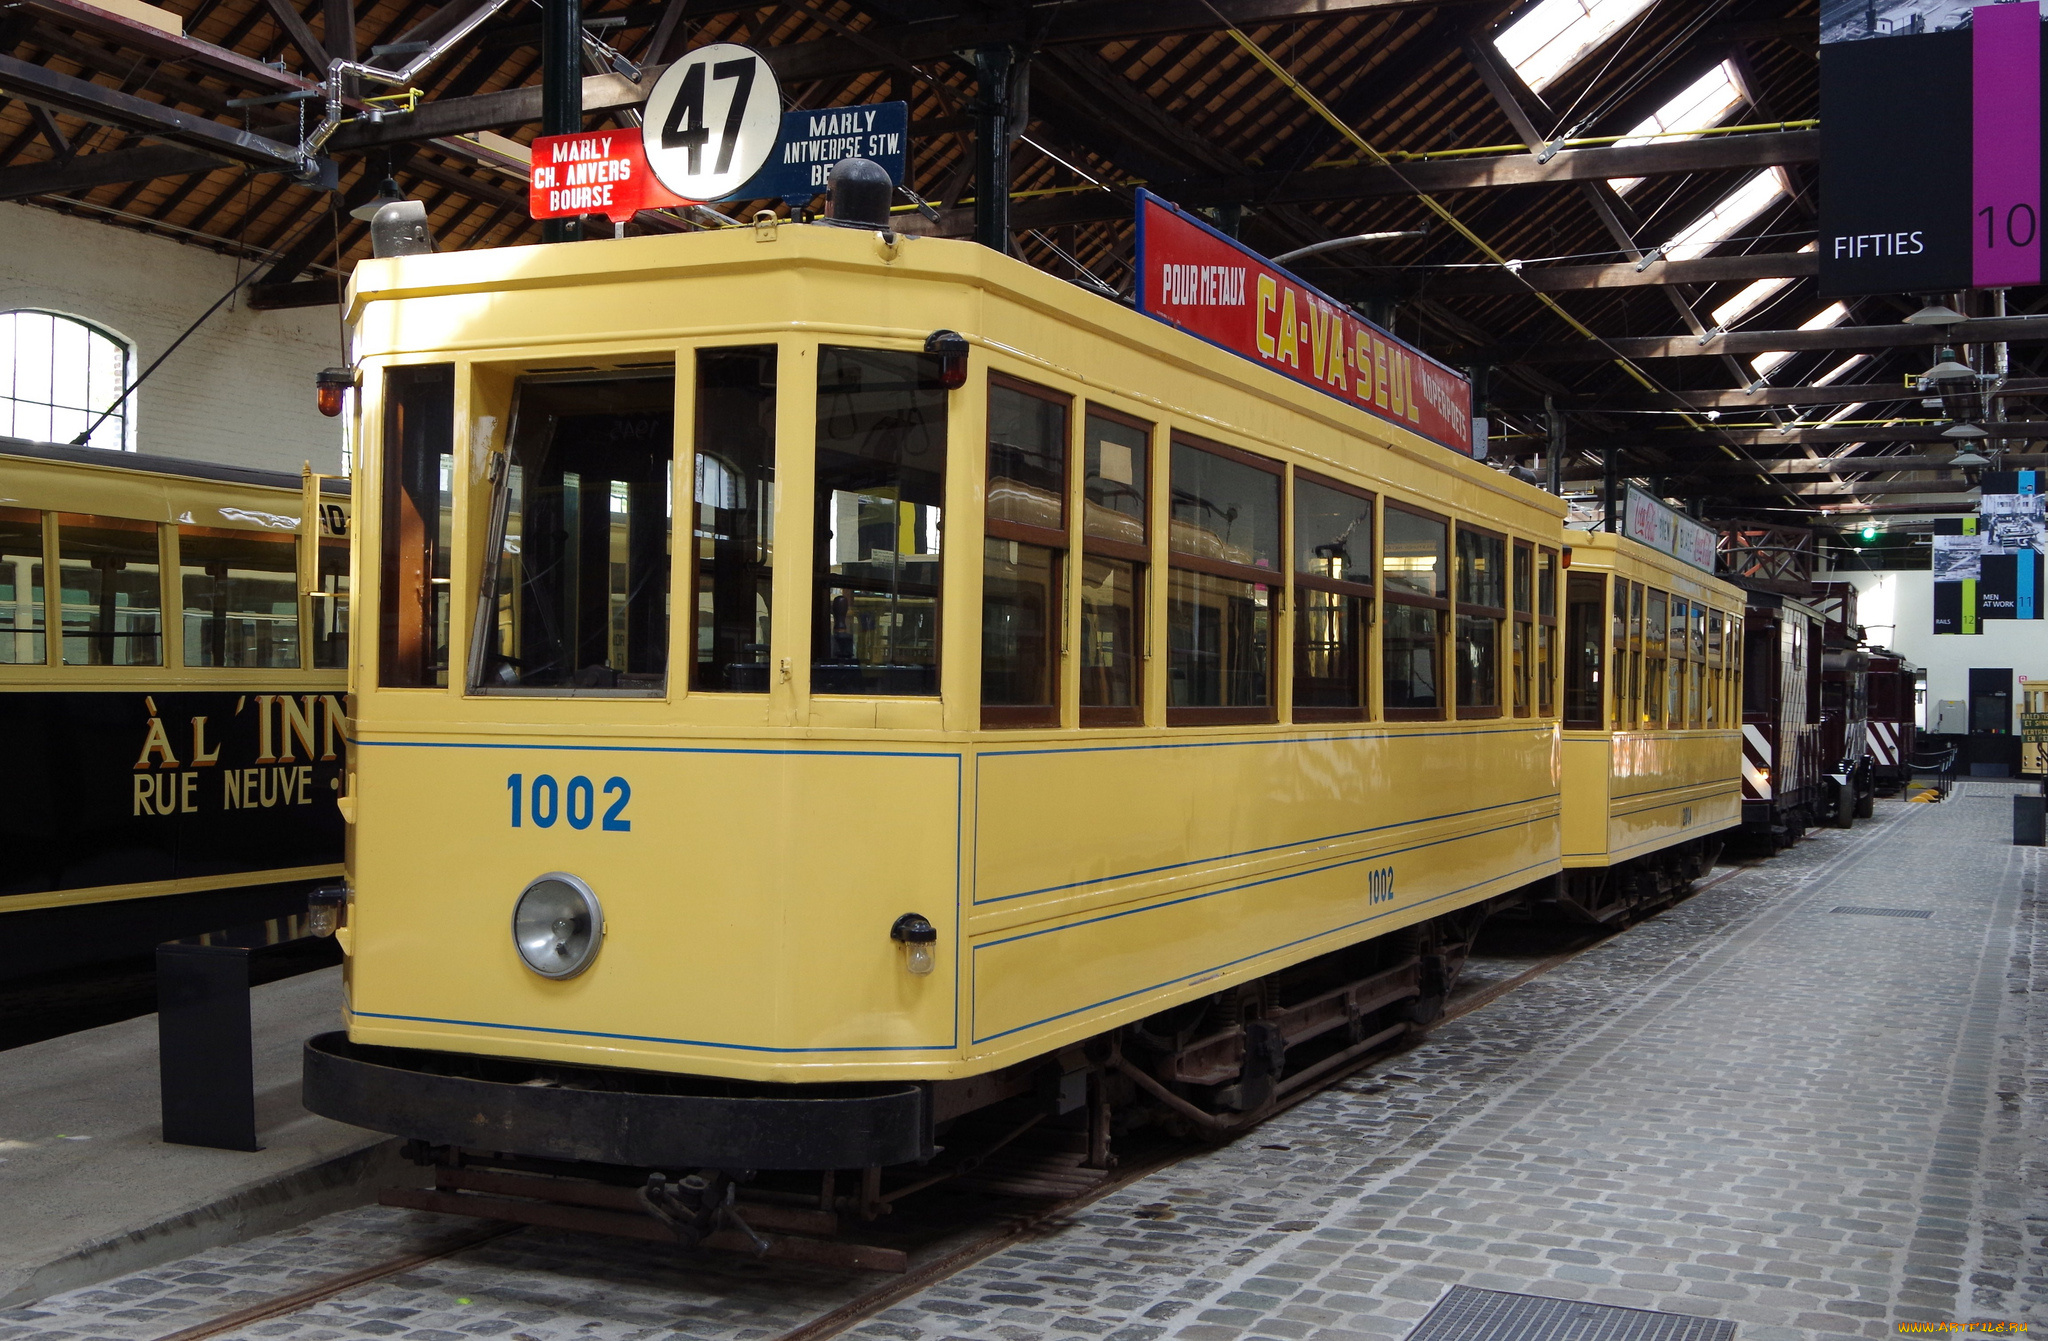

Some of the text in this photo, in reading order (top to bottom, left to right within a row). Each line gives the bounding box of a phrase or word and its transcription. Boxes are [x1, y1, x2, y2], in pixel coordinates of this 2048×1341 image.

[661, 57, 757, 176] 47
[809, 110, 877, 137] MARLY
[553, 137, 612, 163] MARLY
[783, 132, 901, 164] ANTWERPSE STW.
[534, 158, 631, 189] CH. ANVERS
[550, 184, 614, 211] BOURSE
[1834, 203, 2036, 259] FIFTIES 10
[1162, 263, 1198, 305] POUR
[1200, 265, 1246, 306] METAUX
[1421, 368, 1467, 443] KOPERPOETS
[2019, 596, 2032, 607] 11
[1963, 616, 1975, 625] 12
[133, 695, 180, 769] À
[133, 766, 313, 816] RUE NEUVE
[507, 773, 631, 832] 1002
[1369, 866, 1394, 906] 1002
